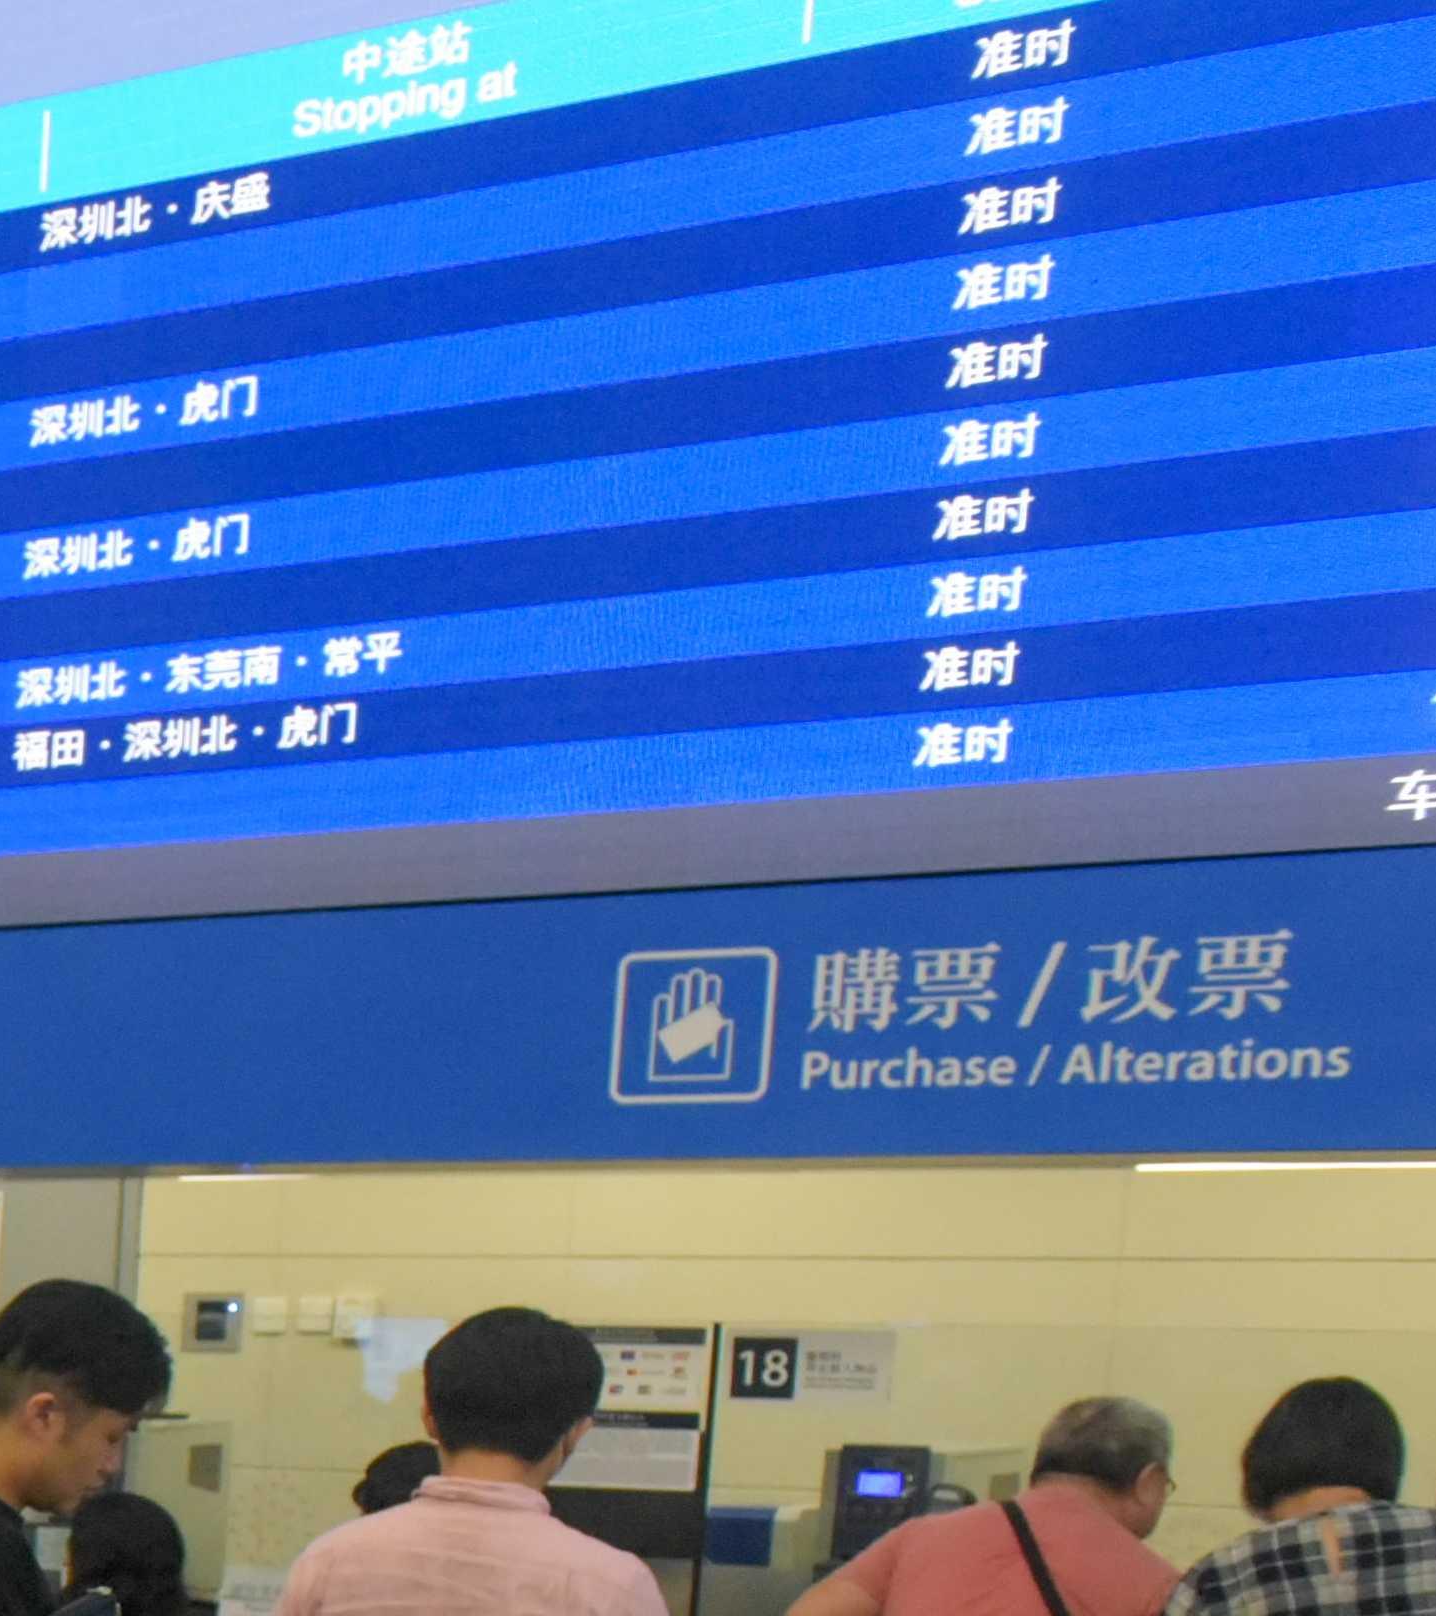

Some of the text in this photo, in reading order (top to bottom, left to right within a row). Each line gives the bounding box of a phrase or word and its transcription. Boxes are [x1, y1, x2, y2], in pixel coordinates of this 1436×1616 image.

[342, 20, 472, 85] 中途站
[972, 19, 1077, 80] 准时
[293, 61, 518, 139] Stopping at
[964, 97, 1070, 156] 准时
[957, 176, 1062, 236] 准时
[952, 254, 1055, 310] 准时
[945, 333, 1048, 390] 准时
[939, 412, 1041, 467] 准时
[932, 488, 1035, 541] 准时
[926, 565, 1029, 618] 准时
[919, 640, 1021, 692] 准时
[912, 717, 1014, 768] 准时
[801, 1039, 1018, 1091] Purchase
[1060, 1035, 1353, 1086] Alterations
[738, 1349, 789, 1388] 18
